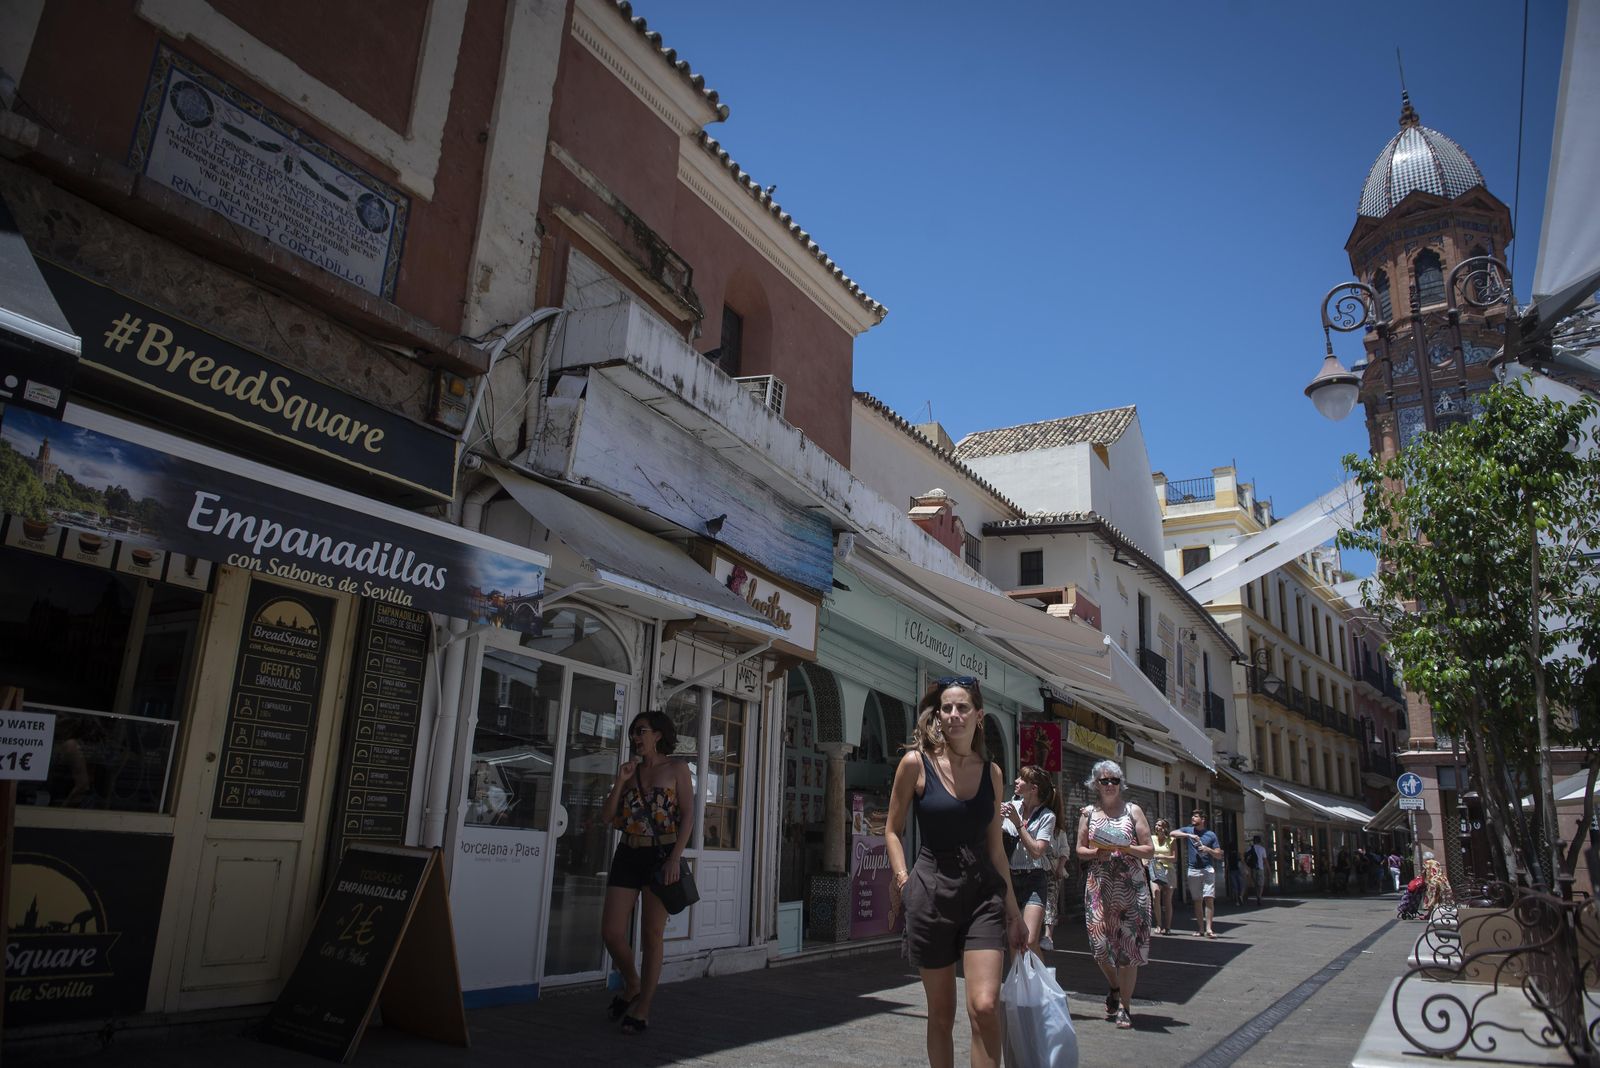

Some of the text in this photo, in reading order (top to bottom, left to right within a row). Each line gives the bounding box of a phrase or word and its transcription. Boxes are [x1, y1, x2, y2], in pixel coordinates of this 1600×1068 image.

[267, 164, 282, 178] LOS
[218, 177, 231, 190] DE
[233, 185, 250, 200] LOS
[271, 207, 309, 233] DONOSOS
[232, 153, 248, 171] DE
[250, 163, 319, 211] CERVANTES
[320, 204, 375, 244] SAAVEDRA
[244, 202, 280, 228] NOVELA
[284, 224, 327, 254] EJEMPLAR
[264, 223, 274, 238] Y
[103, 313, 385, 454] #BreadSquare
[187, 490, 448, 592] Empanadillas
[227, 551, 413, 607] con Sabores de Sevilla
[376, 615, 398, 626] SAVEURS
[406, 621, 423, 632] SEVILLE
[377, 605, 425, 624] EMPANADILLAS
[253, 625, 318, 649] BreadSquare
[249, 642, 260, 650] con
[261, 644, 286, 656] Sabores
[287, 649, 295, 657] de
[910, 621, 983, 676] Chimney cake
[260, 661, 302, 680] OFERTAS
[255, 674, 302, 692] EMPANADILLAS
[8, 720, 45, 731] WATER
[337, 880, 407, 901] EMPANADILLAS
[9, 981, 94, 1002] de Sevilla
